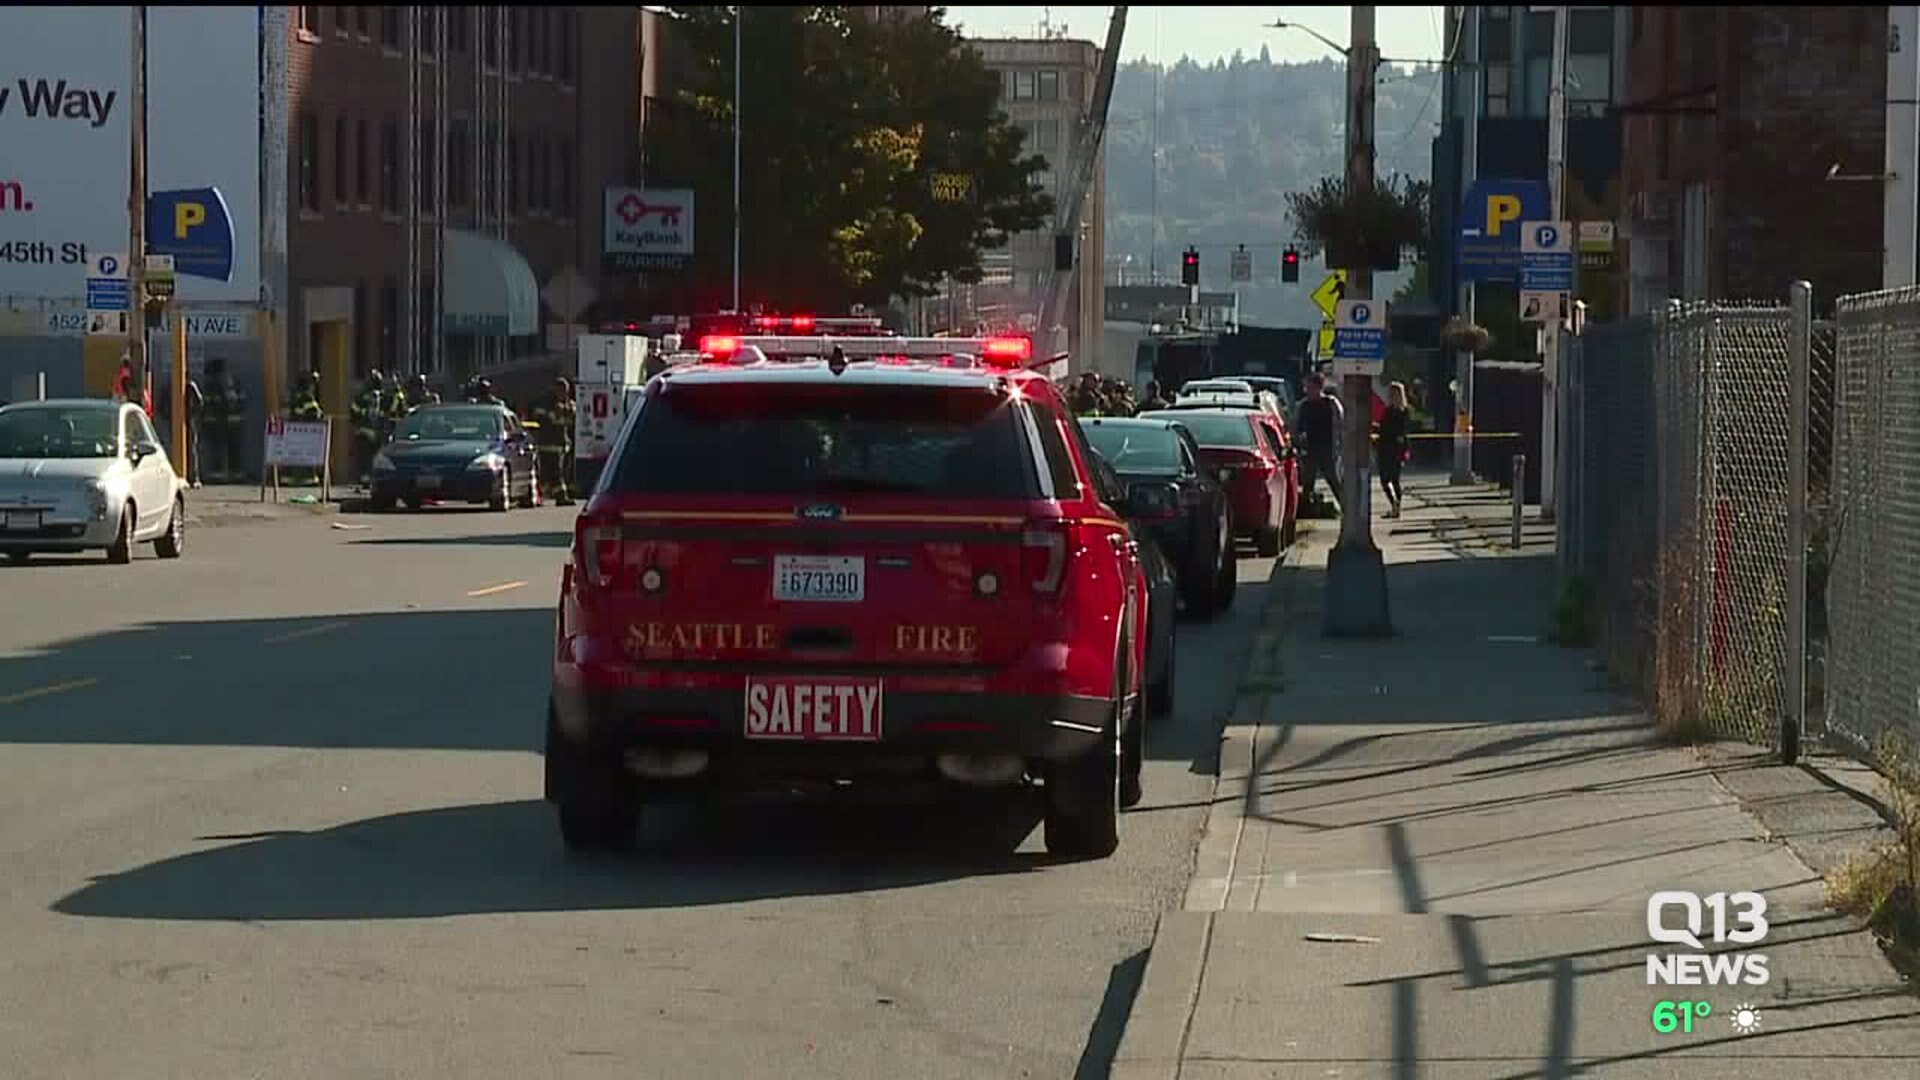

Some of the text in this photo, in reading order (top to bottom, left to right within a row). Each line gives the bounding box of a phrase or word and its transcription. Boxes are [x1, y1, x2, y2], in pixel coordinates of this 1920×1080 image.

[18, 79, 116, 128] Way
[175, 203, 205, 239] P
[1487, 195, 1521, 236] P
[0, 241, 88, 264] 45th St
[615, 230, 682, 247] KeyBank
[804, 505, 833, 518] Ford
[790, 571, 859, 594] 673390
[625, 623, 977, 652] SEATTLE FIRE
[748, 684, 880, 734] SAFETY
